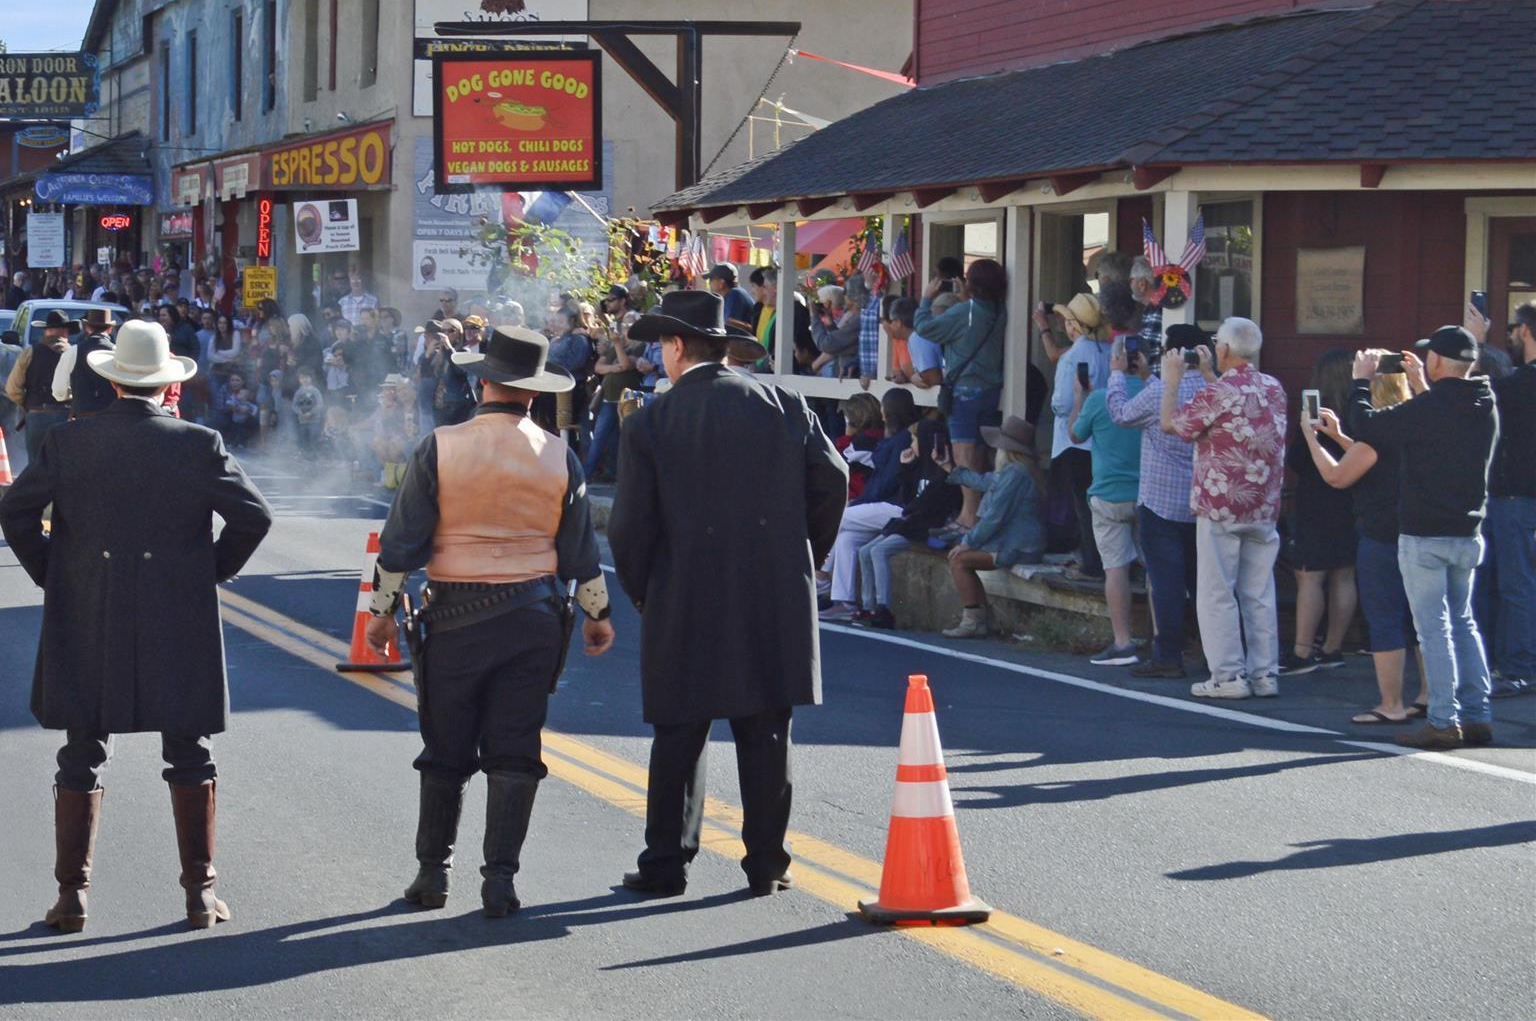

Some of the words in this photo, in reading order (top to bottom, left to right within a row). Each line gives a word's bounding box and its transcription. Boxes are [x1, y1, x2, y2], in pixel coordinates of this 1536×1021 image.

[32, 57, 77, 73] DOOR
[446, 74, 484, 103] DOG
[488, 69, 536, 88] GONE
[540, 70, 589, 99] GOOD
[452, 141, 476, 154] HOT
[518, 140, 550, 153] CHILI
[553, 139, 583, 152] DOGS
[271, 131, 384, 186] ESPRESSO
[447, 161, 485, 173] VEGAN
[488, 161, 517, 173] DOGS
[519, 160, 529, 172] &
[533, 159, 589, 172] SAUSAGES
[101, 217, 130, 228] OPEN
[258, 200, 271, 257] OPEN
